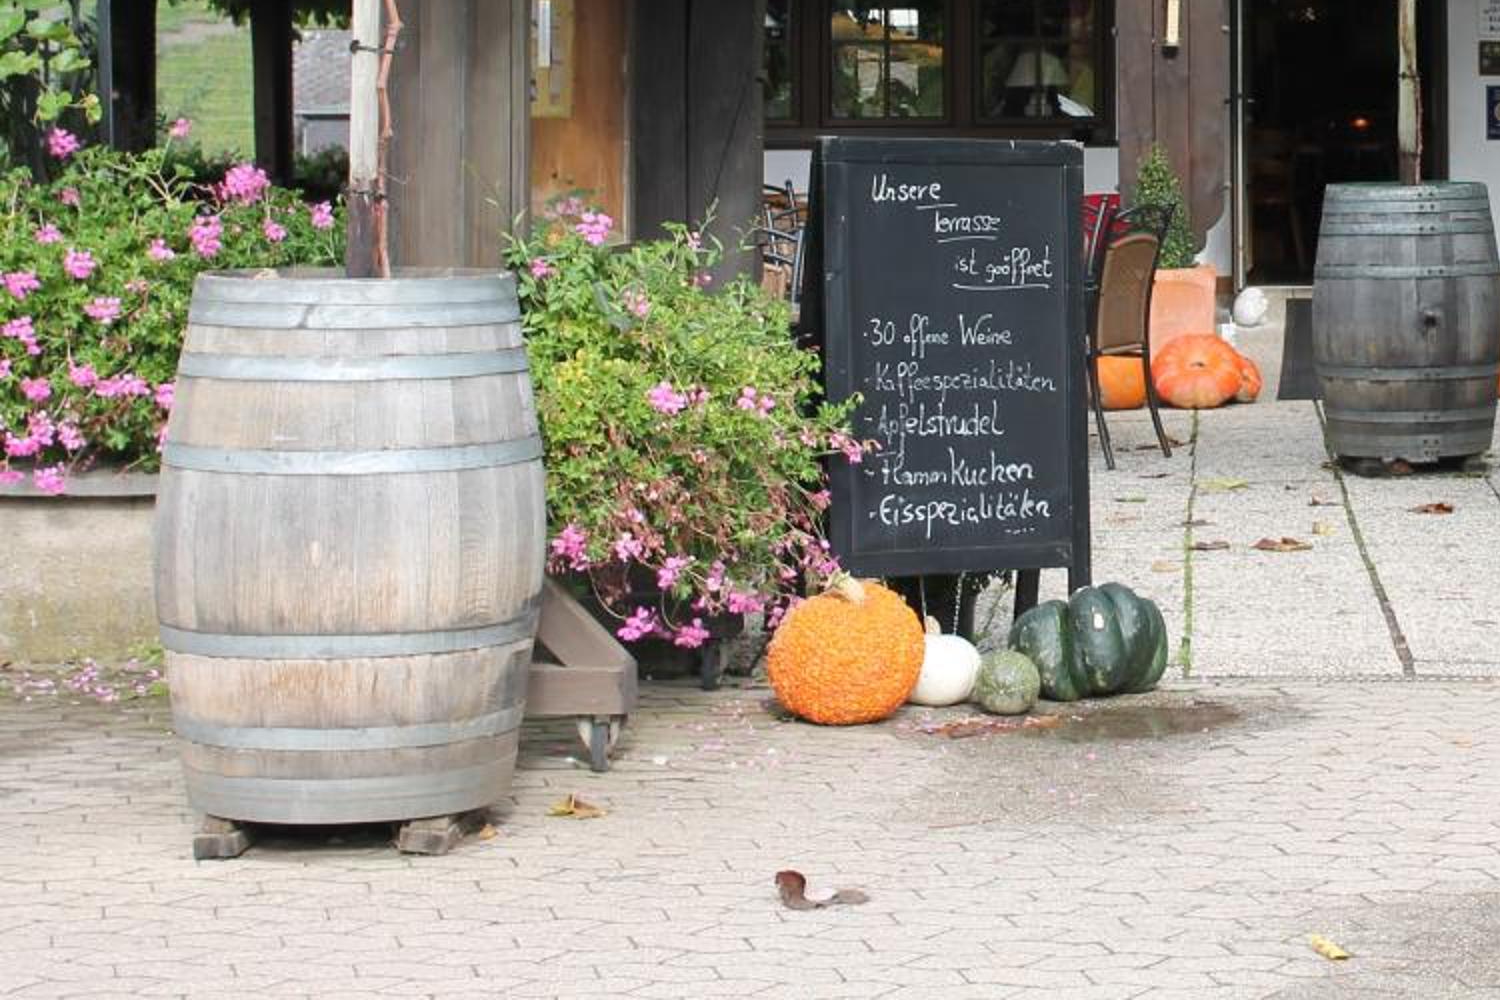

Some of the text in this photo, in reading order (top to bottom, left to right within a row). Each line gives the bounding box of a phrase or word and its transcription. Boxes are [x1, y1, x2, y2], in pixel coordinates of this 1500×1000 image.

[872, 173, 942, 202] Unsere
[916, 203, 1001, 234] Terrasse
[953, 247, 979, 275] ist
[869, 313, 1013, 359] 30 offene Weine
[874, 359, 1057, 404] Kaffeespezialitäten
[877, 399, 1005, 452] Apfelstrudel
[879, 487, 1052, 540] Eisspezialitäten
